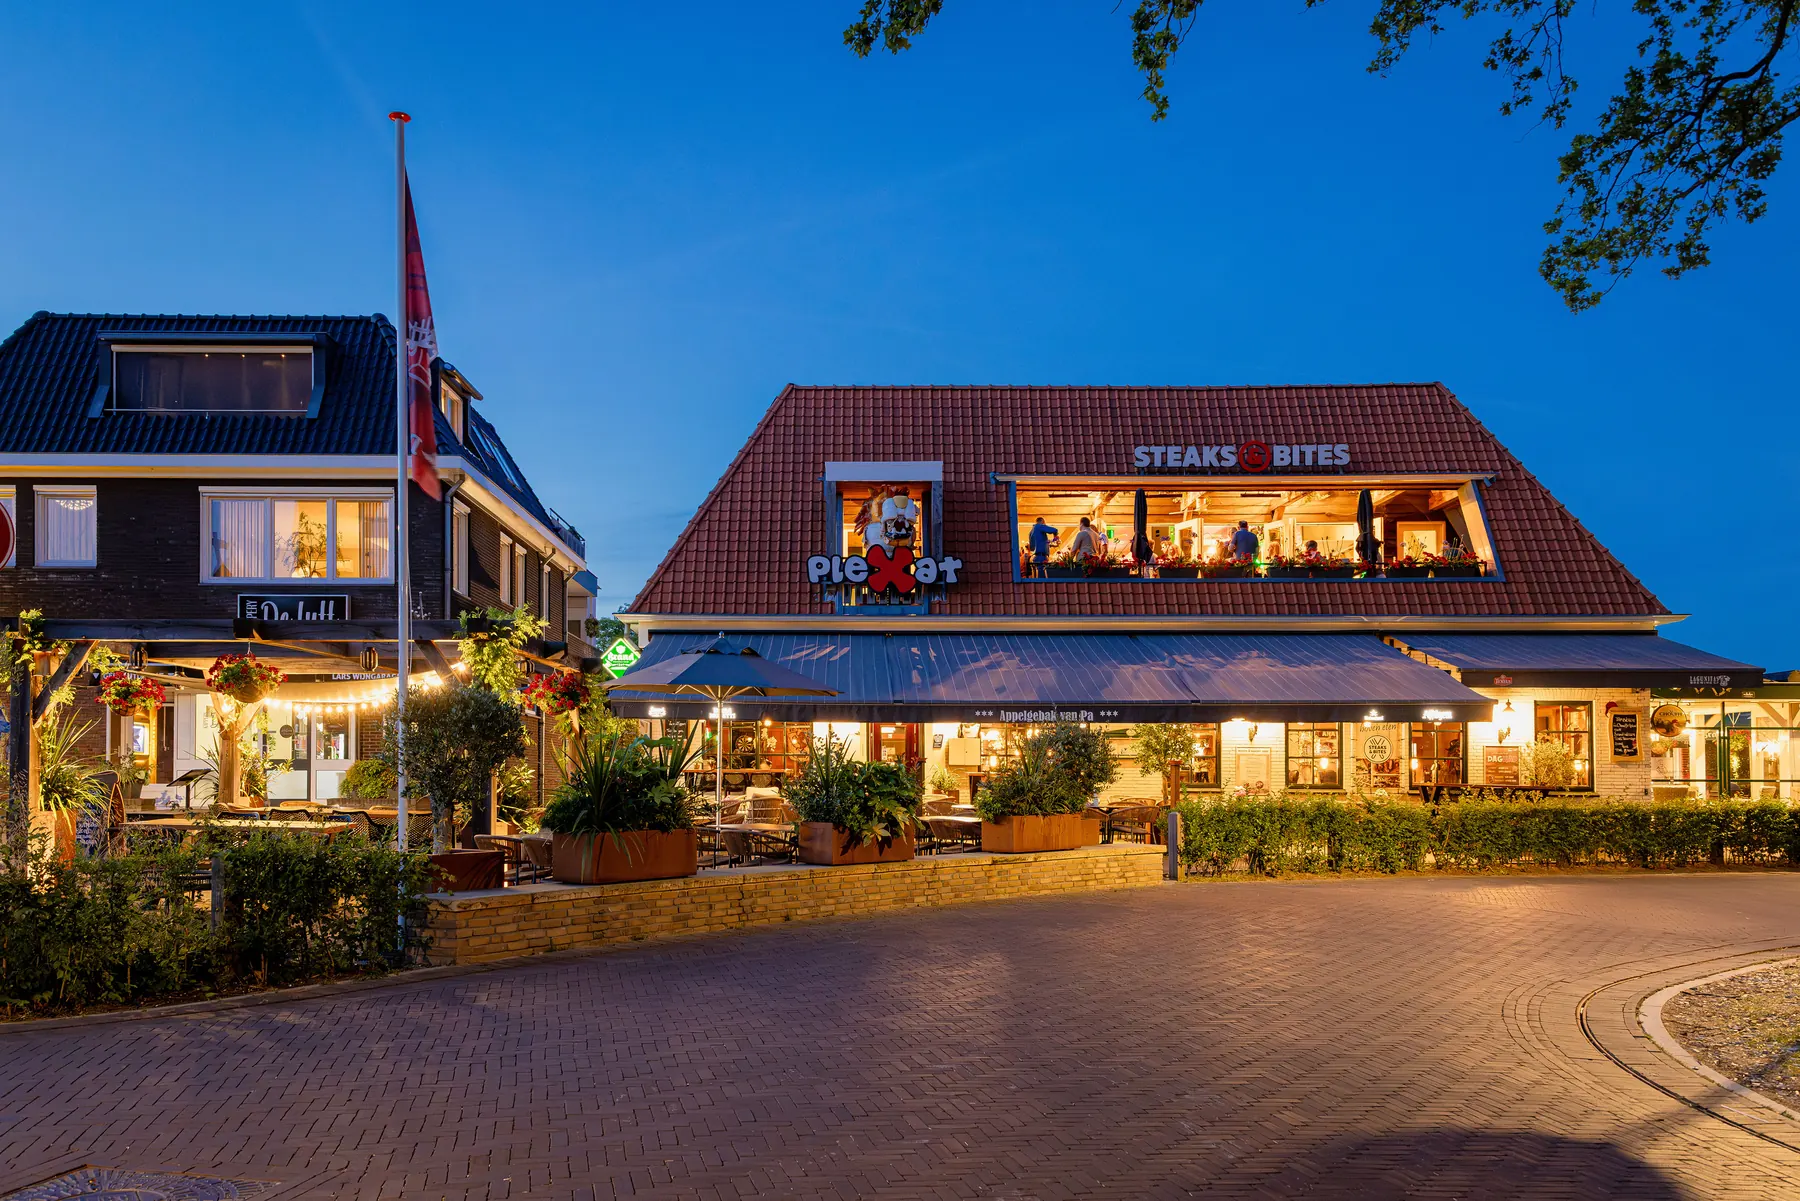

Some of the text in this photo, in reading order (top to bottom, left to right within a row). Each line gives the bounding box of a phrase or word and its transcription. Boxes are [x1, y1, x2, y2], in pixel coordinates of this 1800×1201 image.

[1134, 446, 1237, 467] STEAKS
[1273, 444, 1350, 466] BITES
[1000, 709, 1094, 723] Appelgebak van Pa
